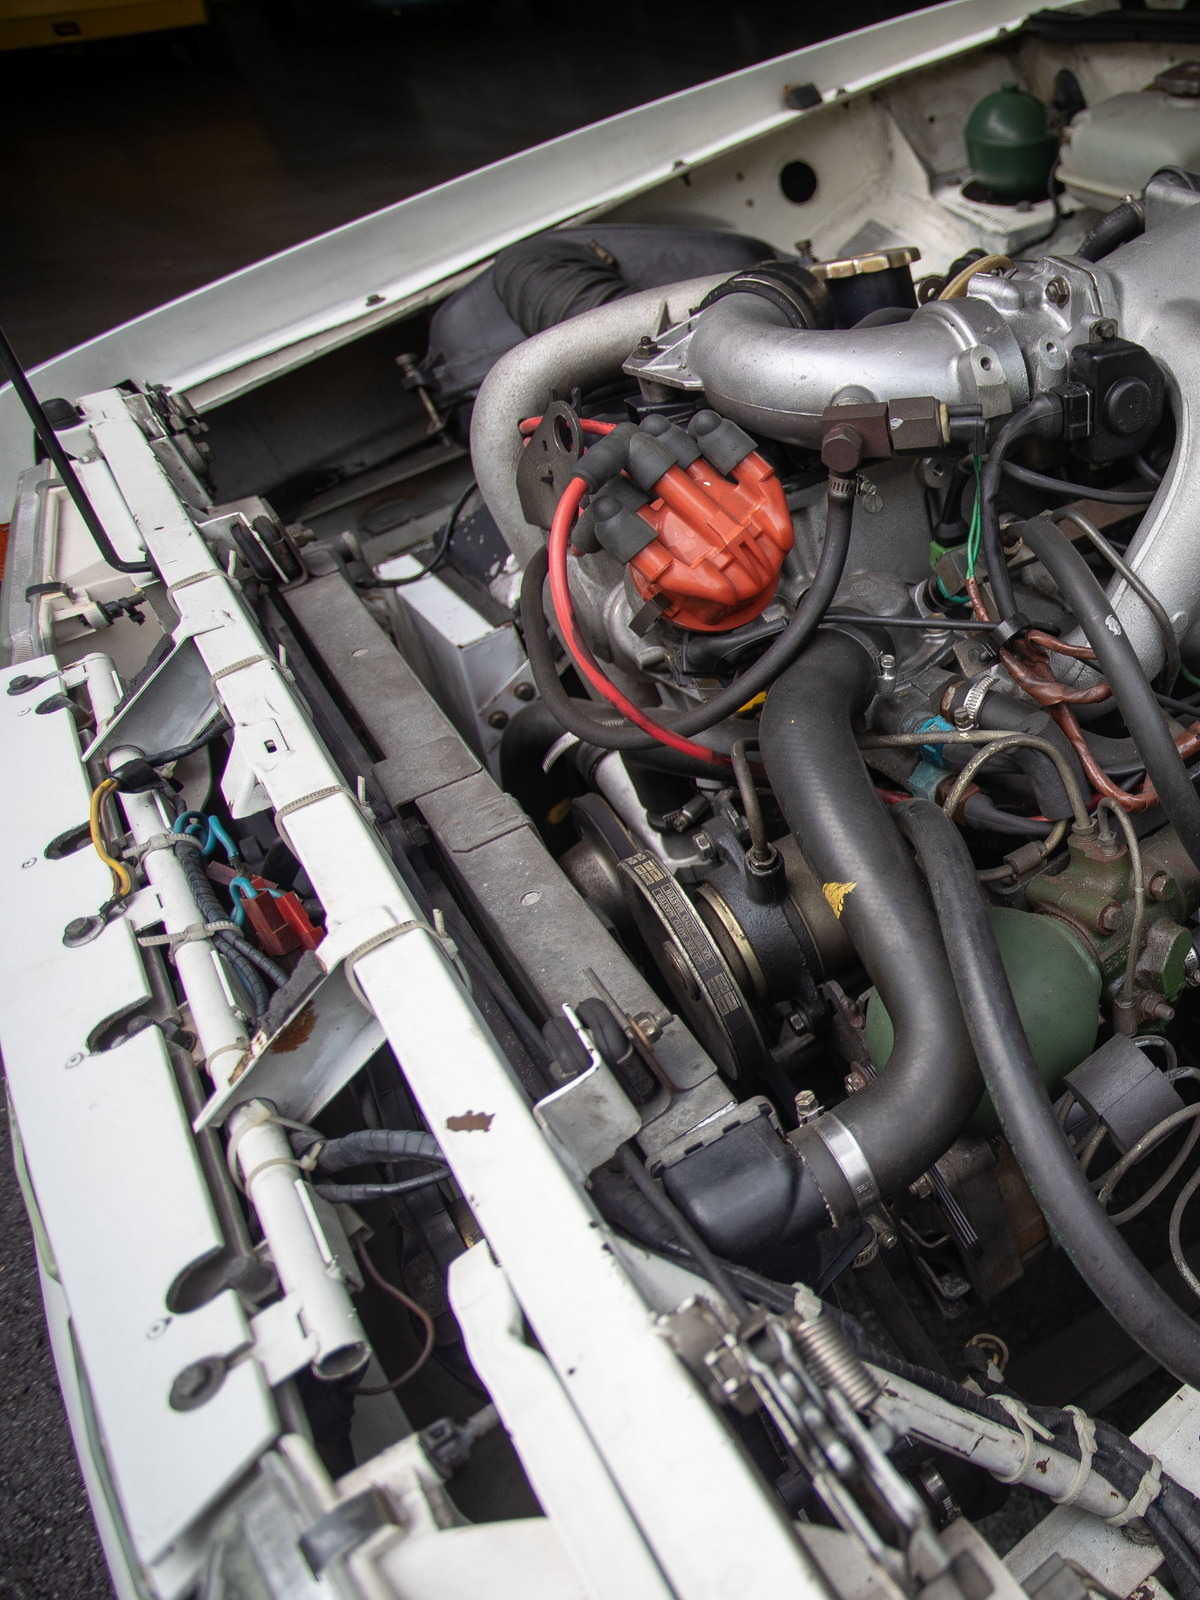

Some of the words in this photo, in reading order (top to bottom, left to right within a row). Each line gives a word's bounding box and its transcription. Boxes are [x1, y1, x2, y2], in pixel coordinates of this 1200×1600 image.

[656, 892, 675, 919] MASTER
[665, 887, 685, 914] MASTER
[672, 918, 688, 939] AUTO
[681, 913, 696, 934] AUTO
